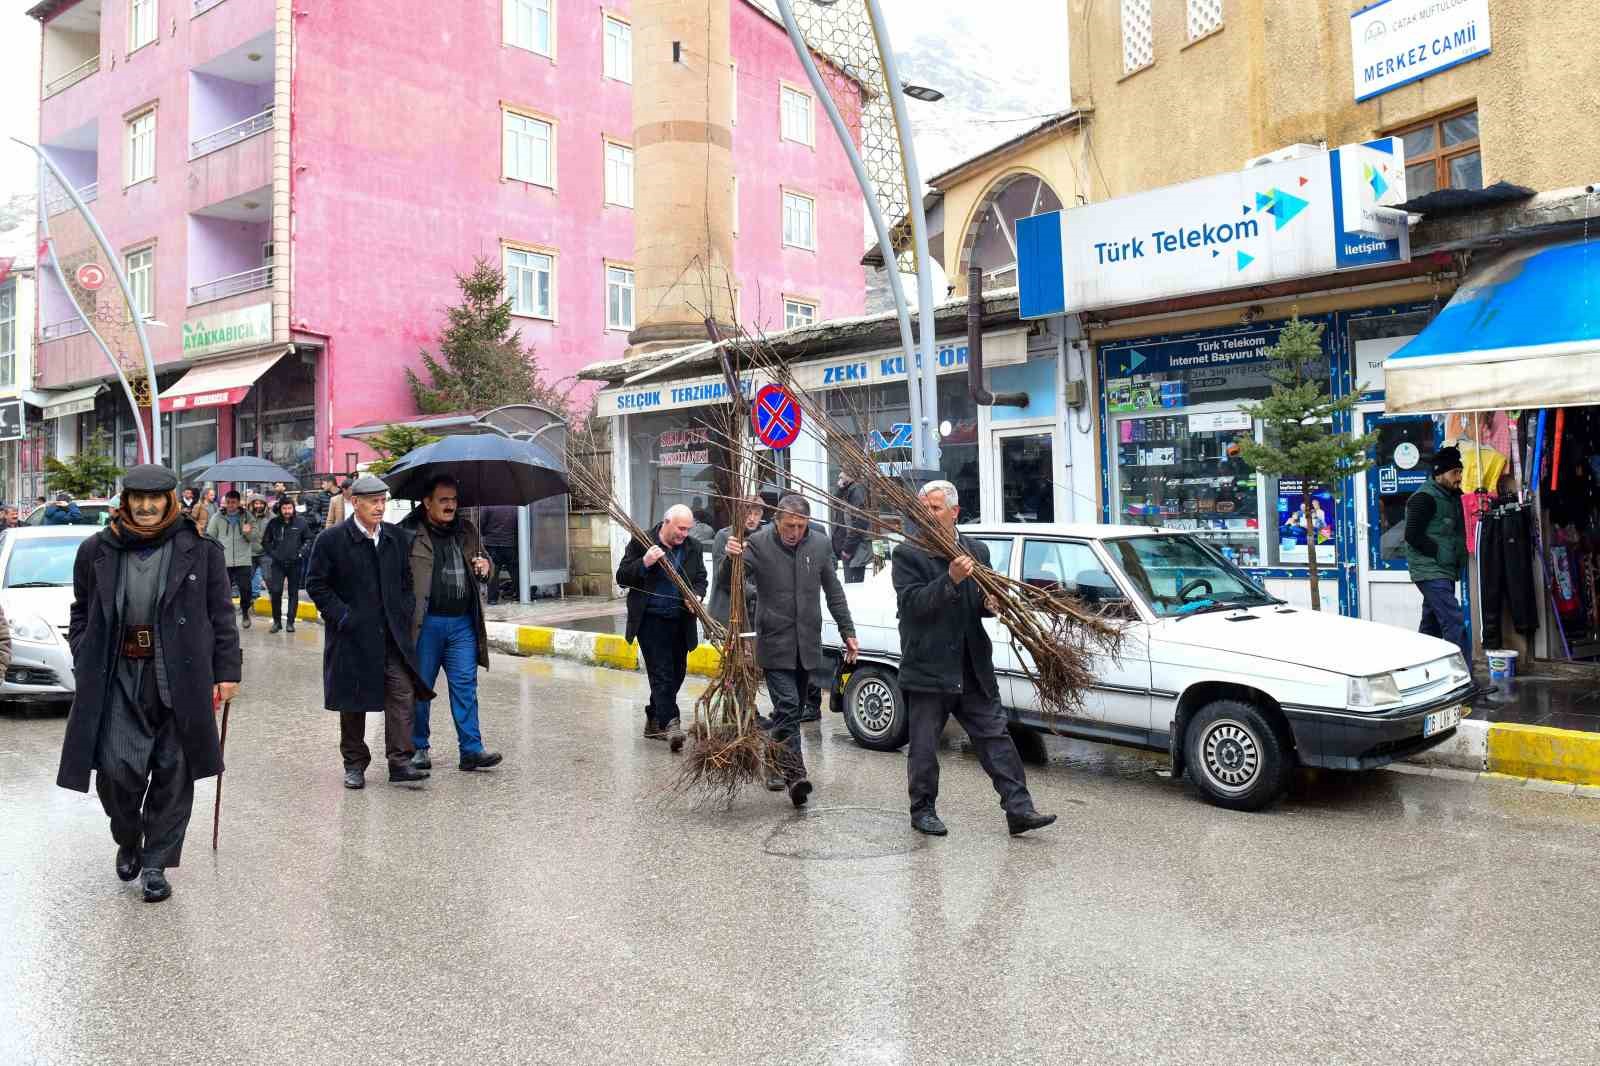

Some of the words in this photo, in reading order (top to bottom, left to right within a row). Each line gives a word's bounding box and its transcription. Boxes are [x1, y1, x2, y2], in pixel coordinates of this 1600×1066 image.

[1364, 44, 1427, 82] MERKEZ
[1432, 20, 1476, 56] CAMİİ
[1094, 237, 1144, 265] Türk
[1152, 219, 1258, 254] Telekom
[1198, 341, 1220, 352] Türk
[1222, 336, 1266, 349] Telekom
[1211, 349, 1253, 363] Başvuru
[823, 363, 868, 385] ZEKİ
[881, 344, 969, 376] KUAÖR
[617, 391, 661, 410] SELÇUK
[671, 378, 752, 403] TERZİHANSİ
